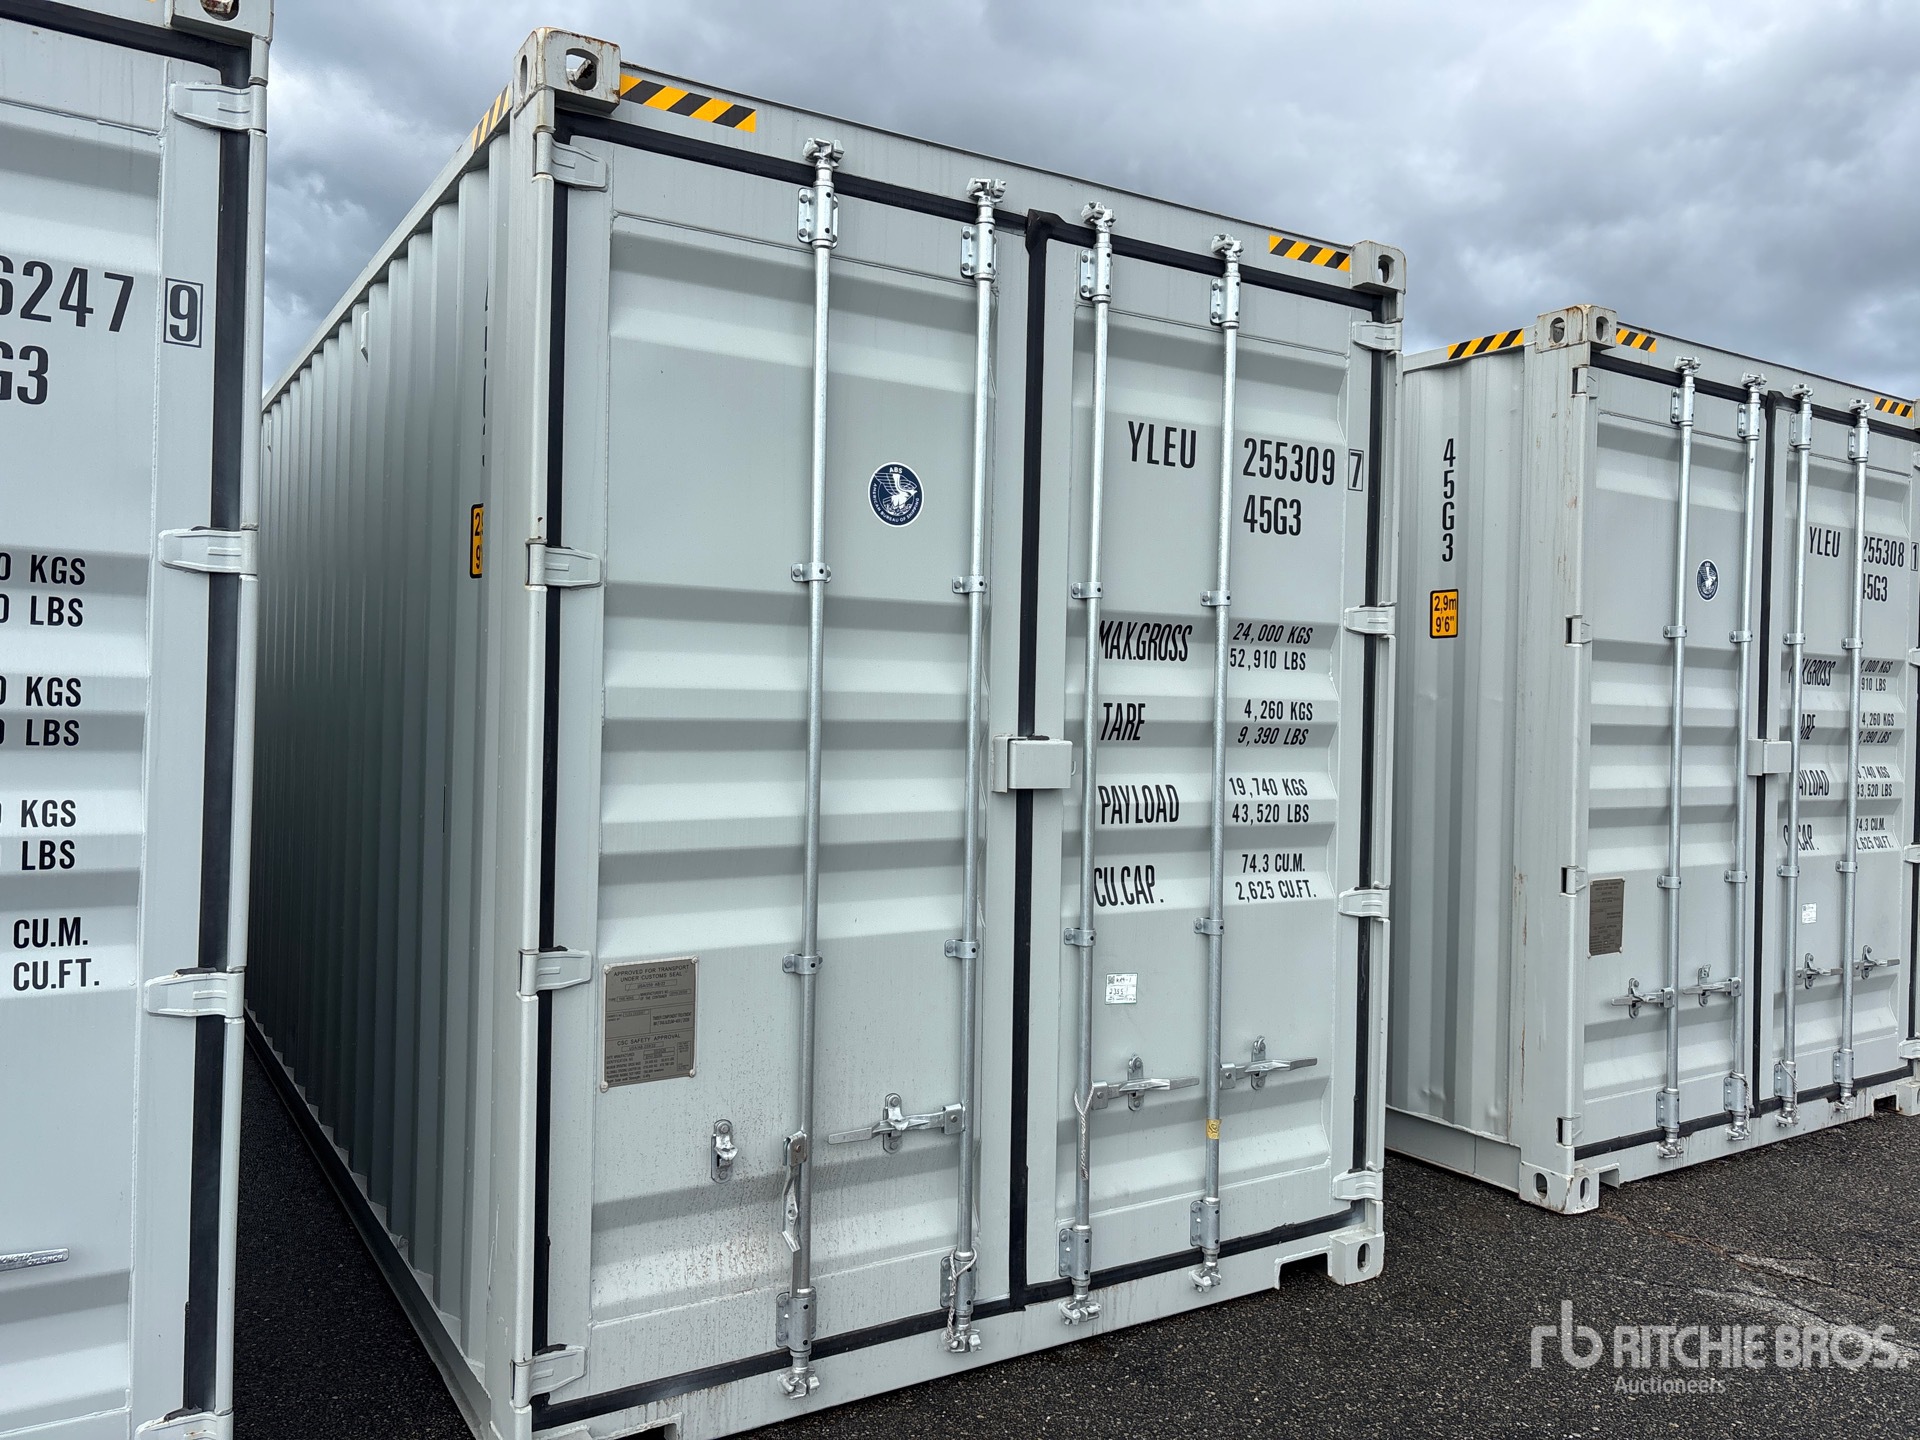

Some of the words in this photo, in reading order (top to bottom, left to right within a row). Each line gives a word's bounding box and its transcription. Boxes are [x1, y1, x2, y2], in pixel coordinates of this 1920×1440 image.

[168, 282, 200, 344] 9
[1128, 421, 1196, 468] YLEU
[1243, 438, 1335, 485] 255309
[1350, 451, 1363, 489] 7
[1442, 438, 1456, 562] 45G3
[1243, 495, 1301, 536] 45G3
[1810, 526, 1840, 557] YLEU
[1912, 543, 1918, 570] 1
[30, 555, 86, 585] KGS
[30, 596, 84, 627] LBS
[1434, 595, 1456, 614] 2,9m
[1100, 620, 1192, 661] MAX.GROSS
[1232, 623, 1285, 644] 24,000
[1287, 626, 1313, 644] KGS
[1230, 648, 1276, 670] 52,910
[1284, 652, 1306, 670] LBS
[1878, 660, 1893, 673] KGS
[26, 676, 82, 707] KGS
[1876, 678, 1886, 691] LBS
[1101, 702, 1145, 741] TARE
[1244, 699, 1284, 722] 4,260
[1290, 702, 1313, 721] KGS
[1862, 712, 1880, 728] 4,260
[1883, 713, 1894, 726] KGS
[26, 719, 80, 746] LBS
[1238, 726, 1280, 747] 9,390
[1283, 728, 1309, 745] LBS
[1800, 714, 1816, 739] ARE
[1877, 731, 1892, 743] LBS
[1799, 770, 1829, 796] AYLOAD
[1875, 766, 1890, 778] KGS
[1229, 778, 1278, 798] 19,740
[1282, 778, 1308, 796] KGS
[1882, 784, 1892, 796] LBS
[21, 800, 76, 828] KGS
[1098, 784, 1180, 824] PAYLOAD
[1232, 804, 1280, 825] 43,520
[1287, 804, 1309, 822] LBS
[22, 840, 75, 870] LBS
[1242, 854, 1269, 873] 74.3
[1275, 853, 1305, 872] CU.M.
[1094, 865, 1164, 907] CU.CAP.
[1235, 881, 1274, 903] 2,625
[1278, 880, 1316, 899] CU.FT.
[13, 917, 88, 948] CU.M.
[13, 958, 99, 991] CU.FT.
[614, 969, 642, 977] APPROVED
[658, 964, 689, 972] TRANSPORT
[654, 1033, 680, 1041] APPROVAL
